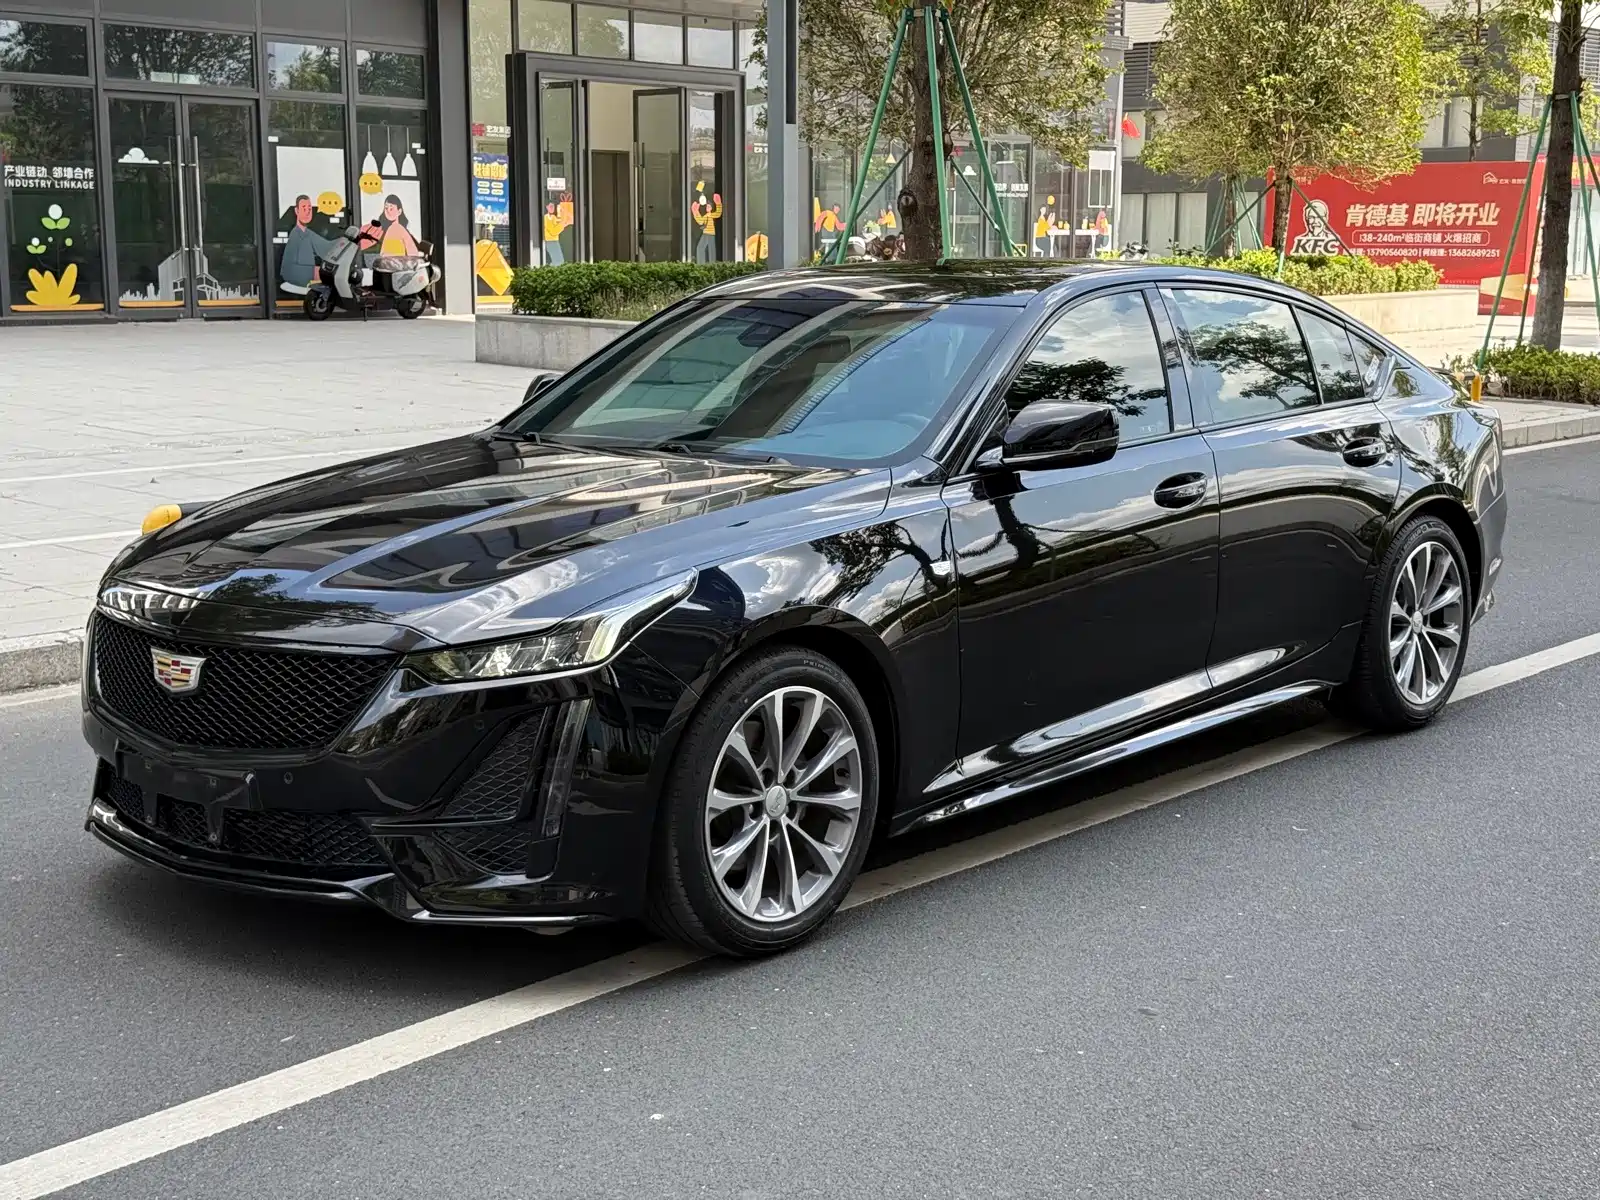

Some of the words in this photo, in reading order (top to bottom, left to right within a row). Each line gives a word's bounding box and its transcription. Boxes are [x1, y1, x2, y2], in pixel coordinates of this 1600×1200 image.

[4, 179, 52, 188] INDUSTRY
[55, 181, 95, 190] LINKAGE
[1345, 203, 1409, 227] 肯德基
[1412, 202, 1500, 227] 即将开业
[1292, 239, 1340, 255] KFC
